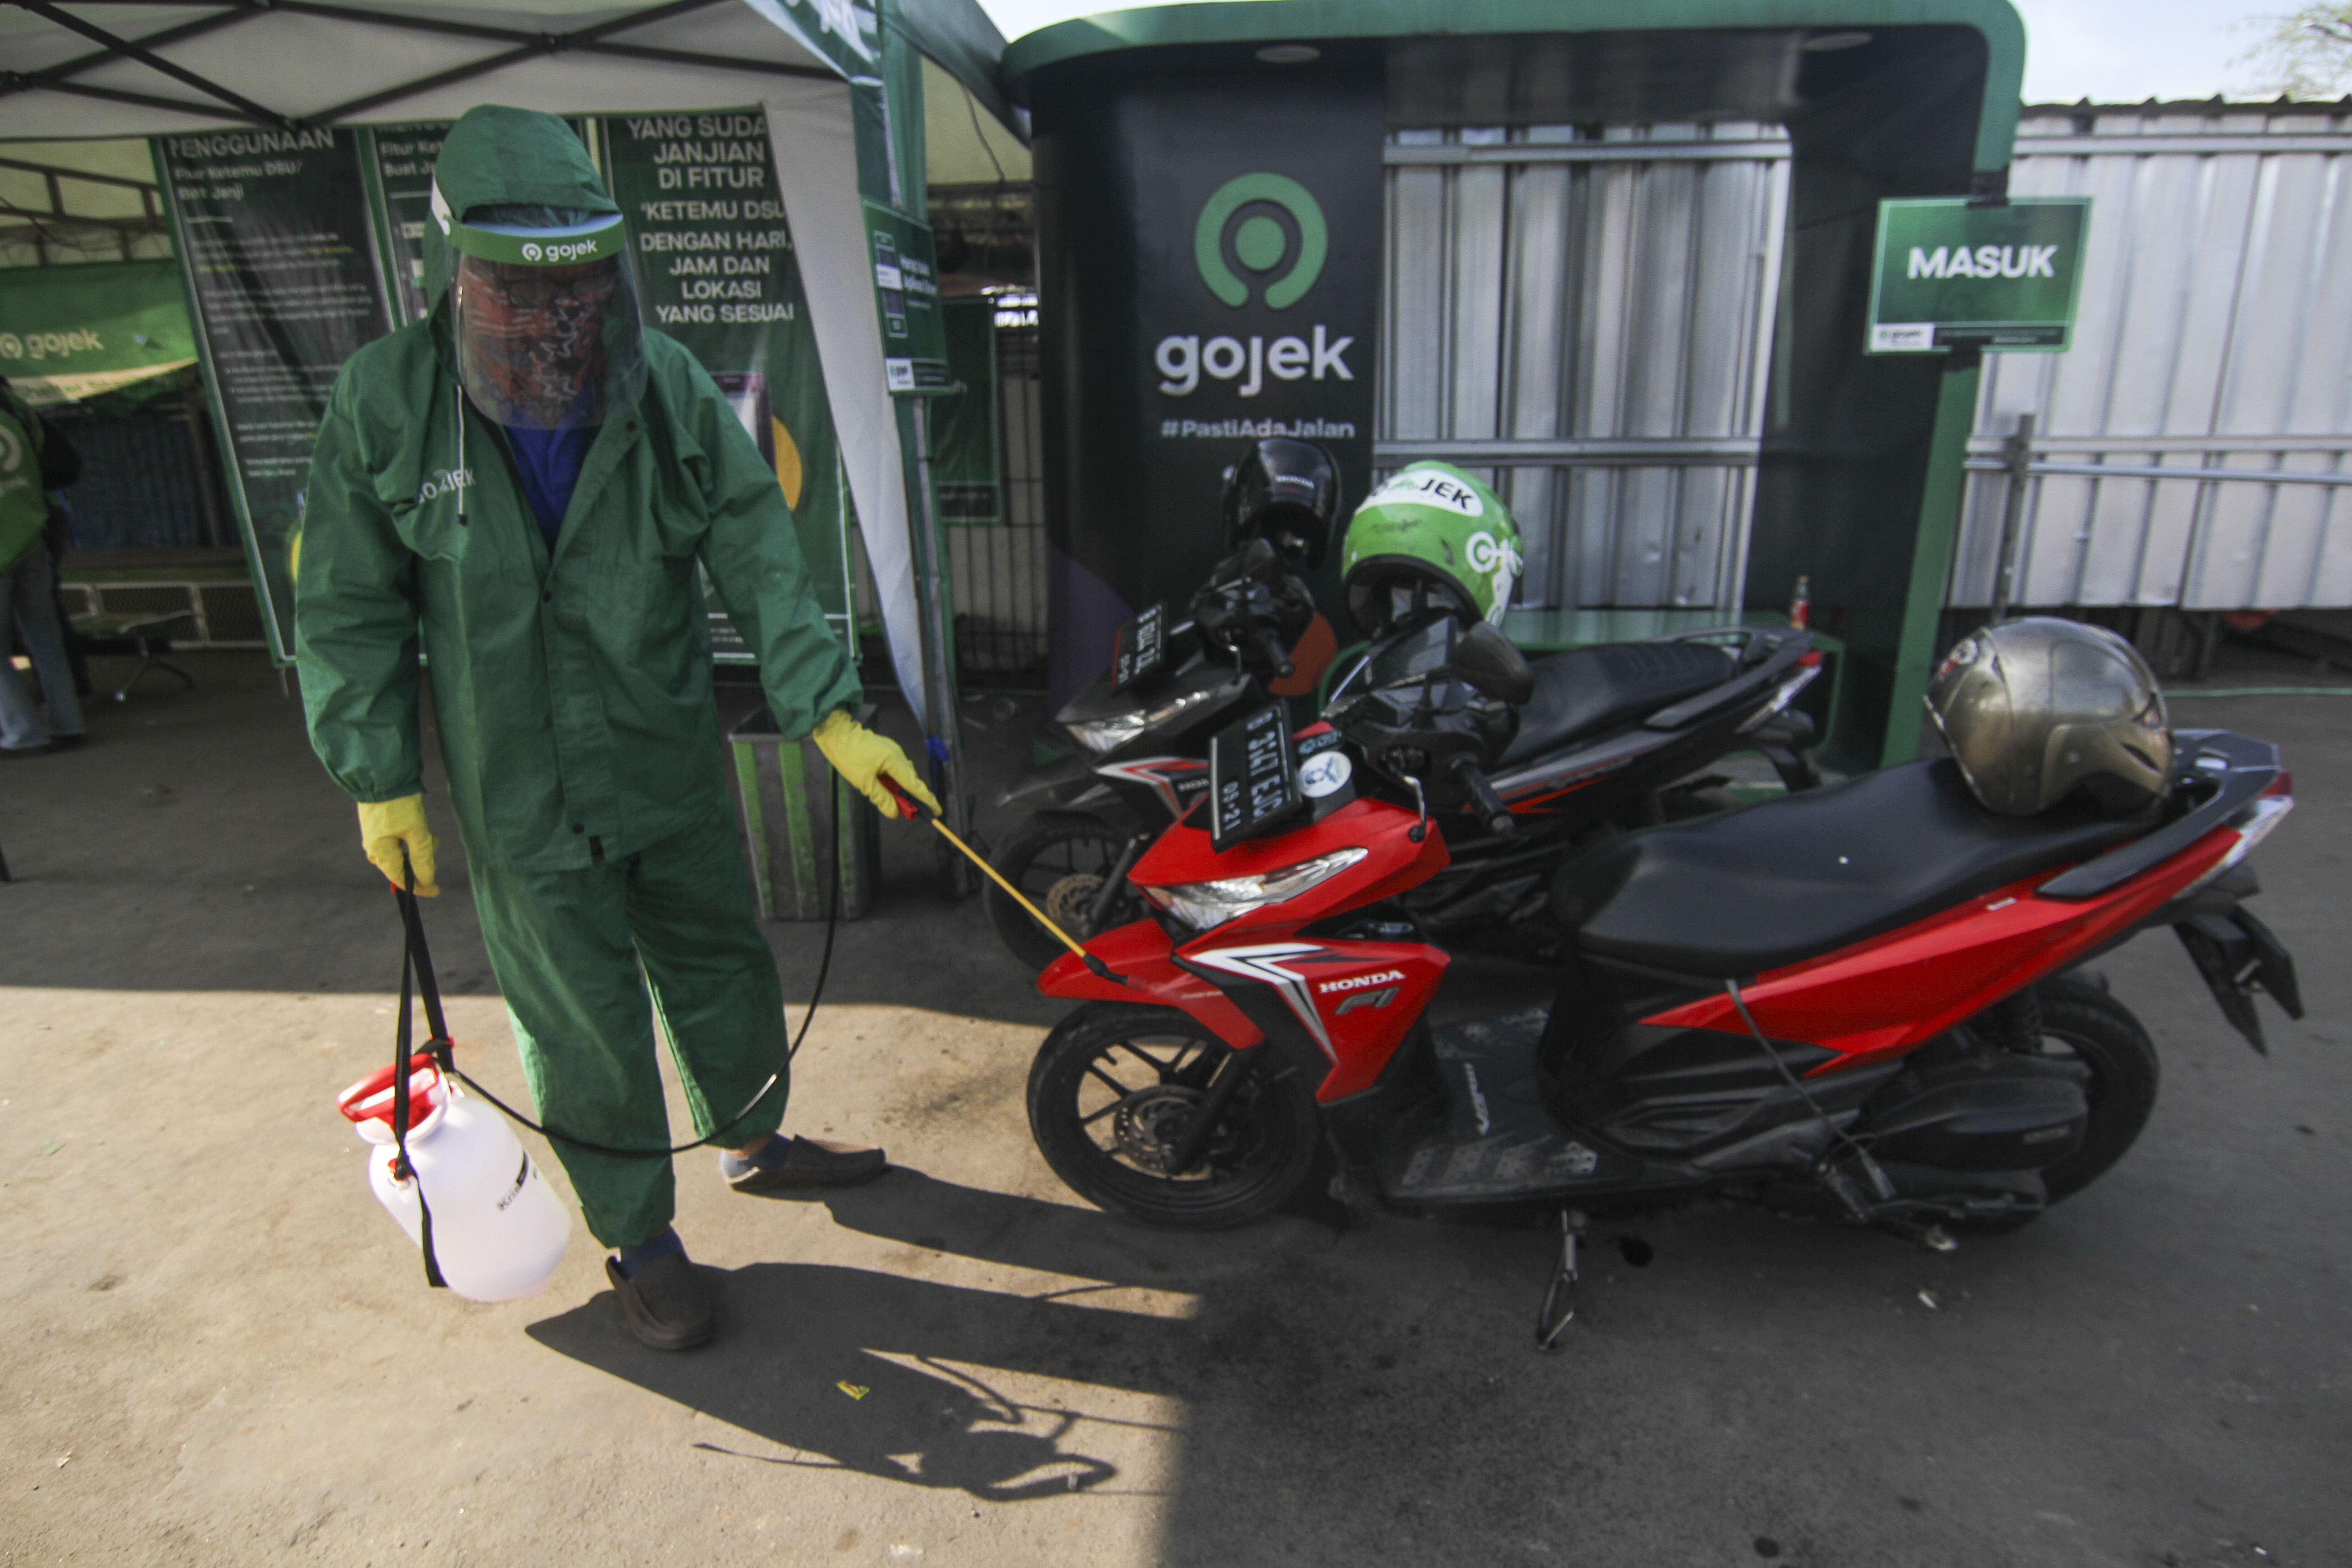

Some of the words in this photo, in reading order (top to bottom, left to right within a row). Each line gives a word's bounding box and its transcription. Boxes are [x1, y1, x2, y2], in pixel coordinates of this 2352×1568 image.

[628, 116, 693, 139] YANG
[653, 142, 765, 163] JANJIAN
[659, 168, 681, 189] DI
[688, 166, 764, 189] FITUR
[545, 239, 598, 262] gojek
[639, 231, 732, 251] DENGAN
[669, 256, 718, 276] JAM
[723, 255, 770, 275] DAN
[1906, 243, 2059, 280] MASUK
[681, 280, 761, 300] LOKASI
[655, 304, 716, 324] YANG
[719, 302, 794, 323] SESUAI
[25, 326, 106, 360] gojek
[1154, 323, 1355, 397] gojek
[1161, 417, 1356, 439] #PastiAdaJalan
[1319, 970, 1406, 994] HONDA
